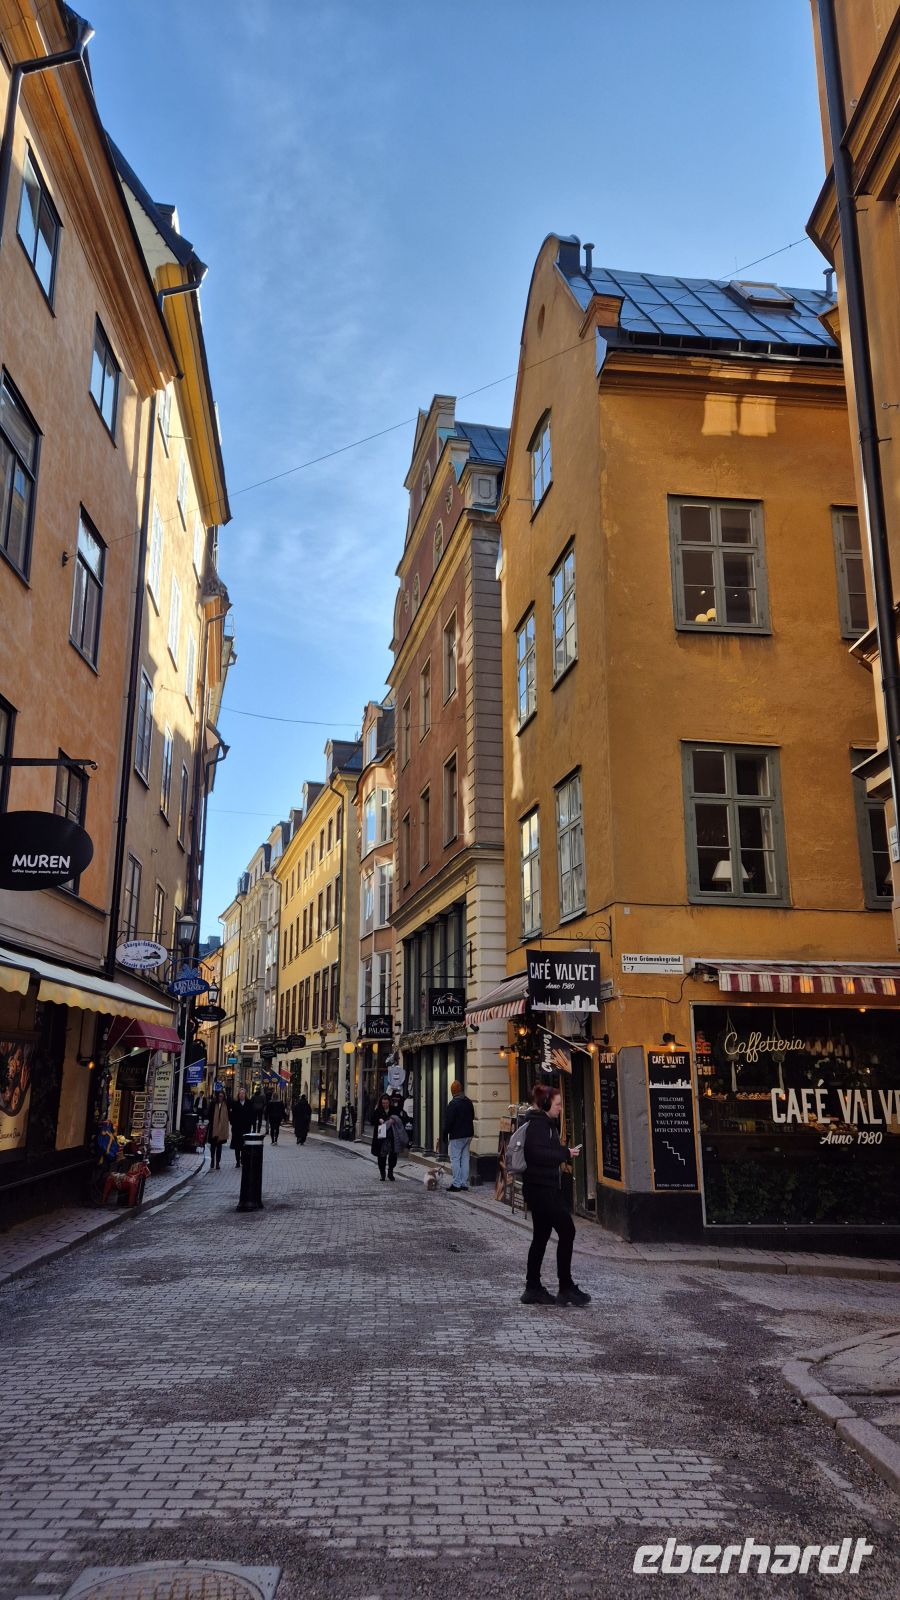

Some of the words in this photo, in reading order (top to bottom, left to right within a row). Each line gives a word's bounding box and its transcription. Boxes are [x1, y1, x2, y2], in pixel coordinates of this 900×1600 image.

[12, 854, 71, 869] MUREN
[529, 959, 551, 980] CAFÉ
[554, 963, 596, 981] VALVET
[432, 1005, 463, 1015] PALACE
[541, 1034, 553, 1073] Churros
[724, 1031, 806, 1063] Caffetteria
[651, 1054, 665, 1064] CAFÉ
[666, 1055, 685, 1065] VALVET
[771, 1078, 831, 1124] CAFÉ
[819, 1130, 854, 1145] Anno
[856, 1131, 883, 1145] 1980
